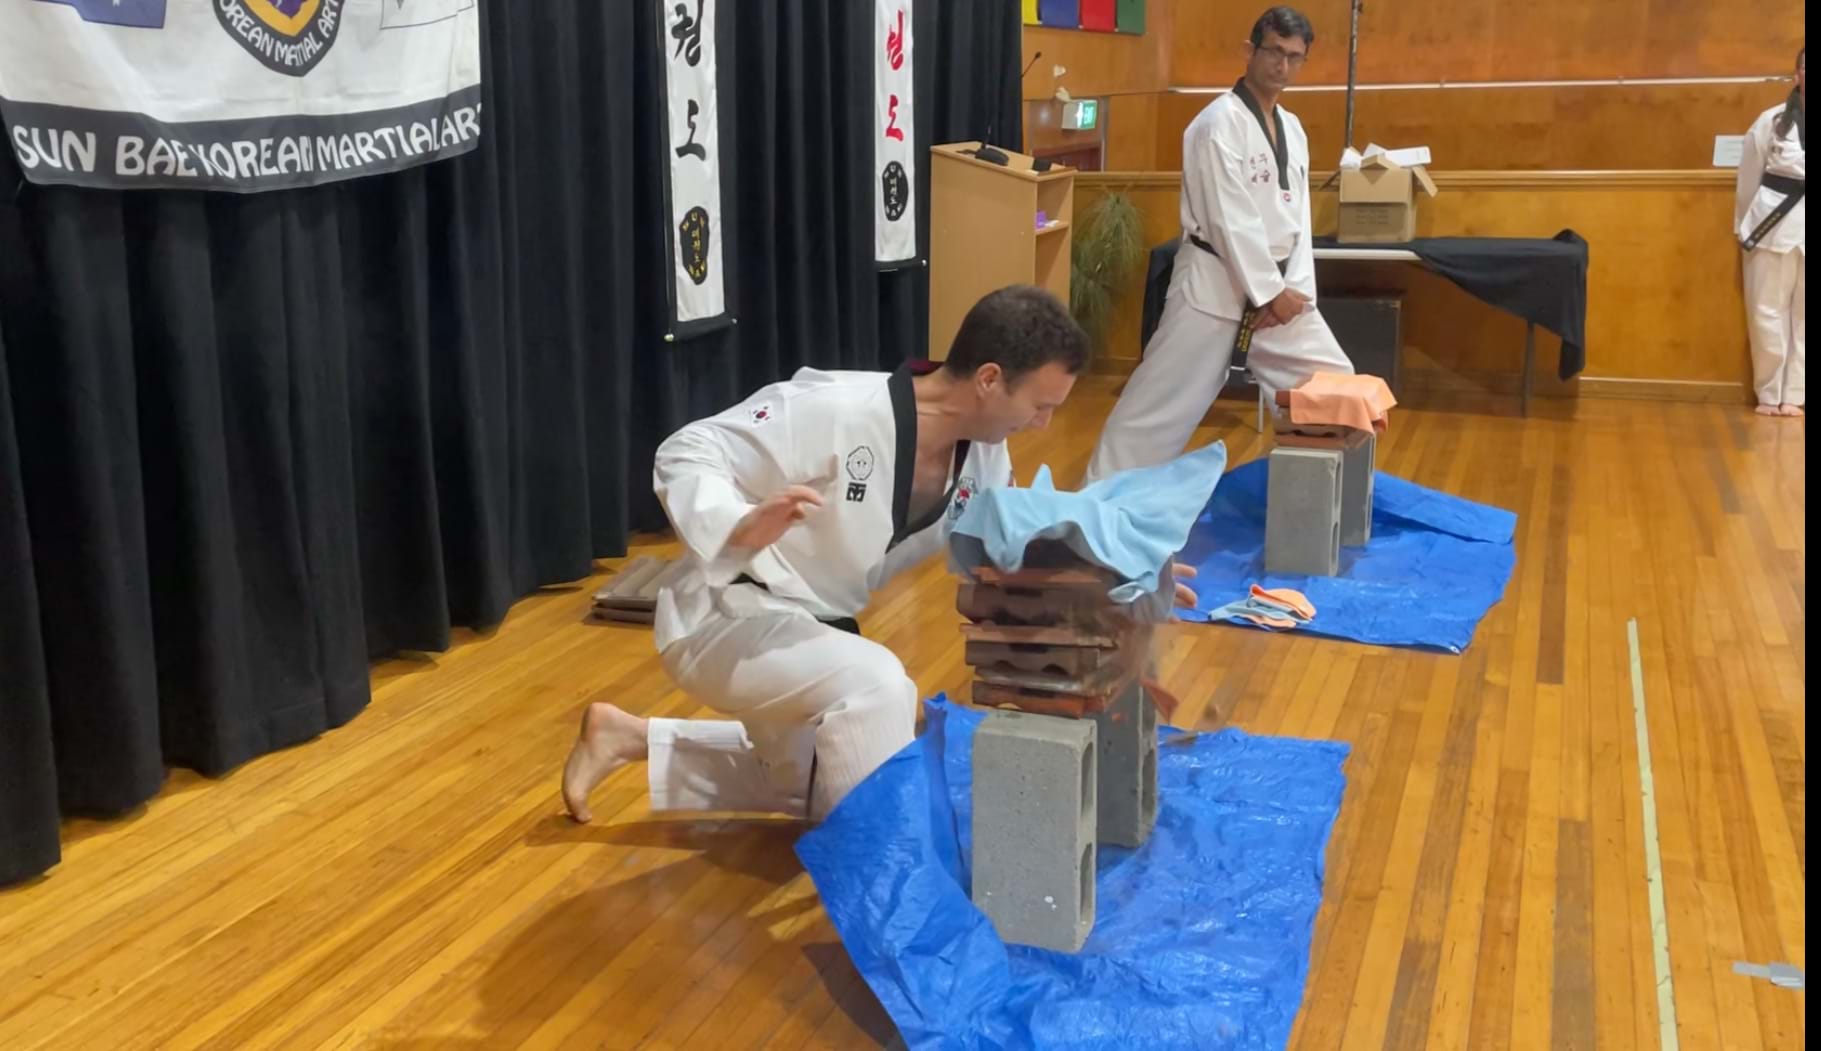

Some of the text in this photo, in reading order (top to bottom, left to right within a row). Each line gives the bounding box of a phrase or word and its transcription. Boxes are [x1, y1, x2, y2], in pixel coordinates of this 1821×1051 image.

[220, 0, 273, 57] OREAN
[13, 125, 96, 172] SUN
[115, 136, 198, 176] BAE
[316, 118, 440, 171] MARTIAL
[440, 103, 482, 147] AR
